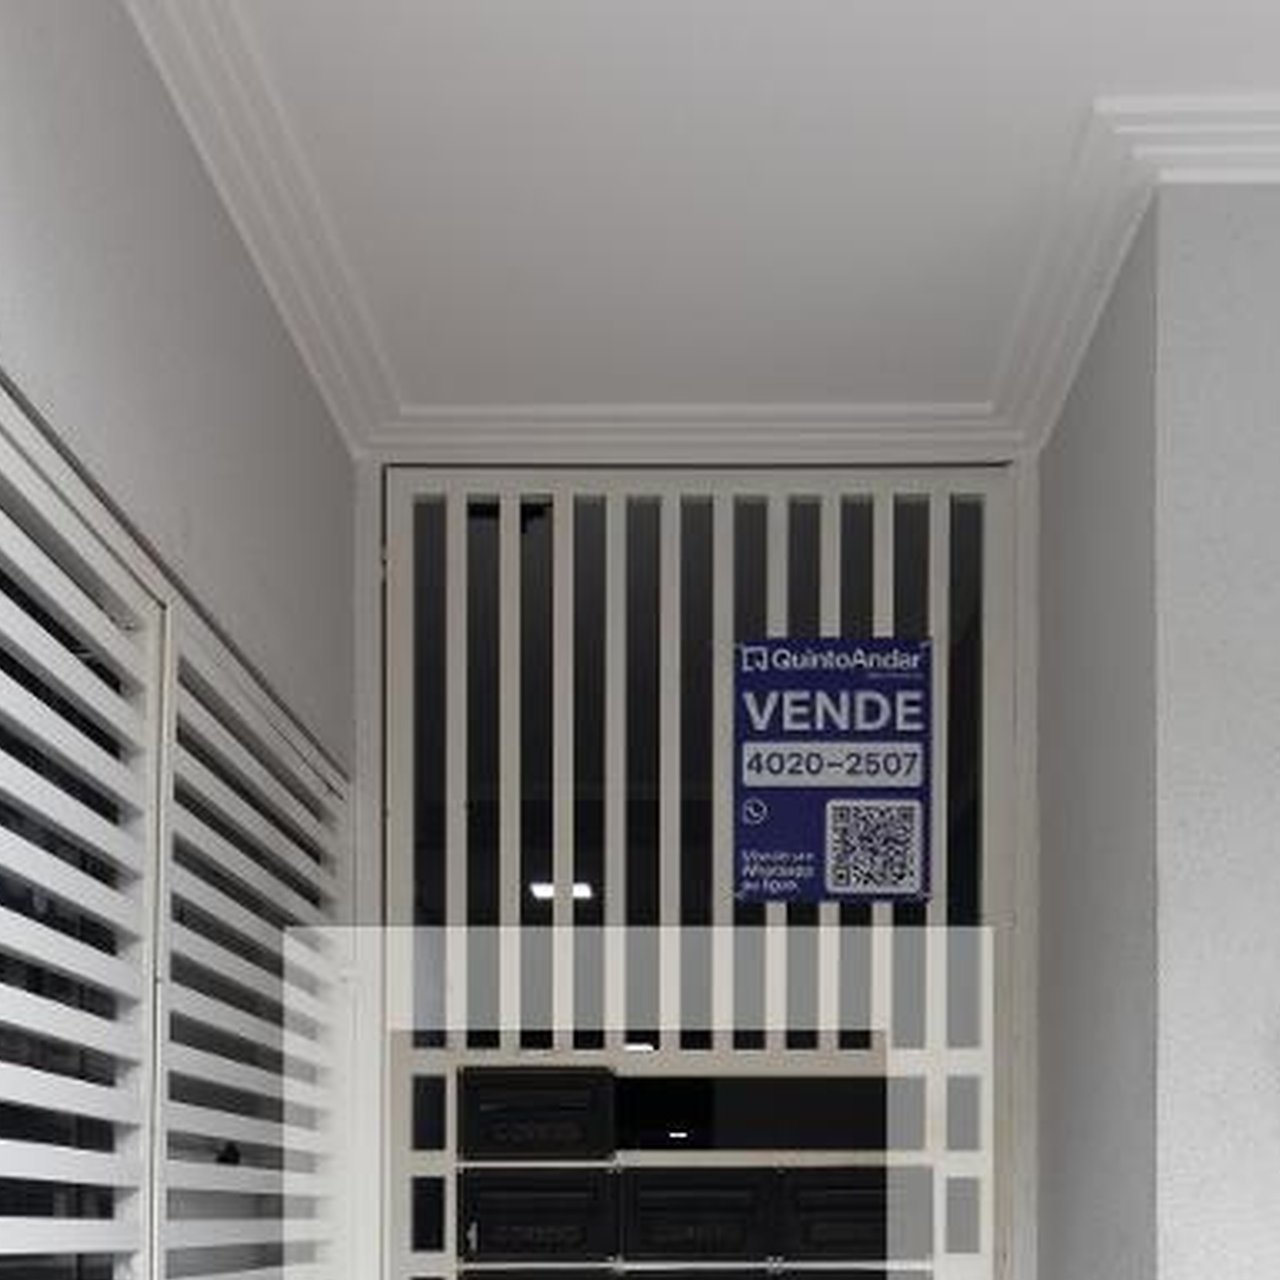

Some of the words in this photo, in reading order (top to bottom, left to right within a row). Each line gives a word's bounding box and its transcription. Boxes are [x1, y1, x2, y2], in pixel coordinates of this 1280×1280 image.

[772, 648, 920, 670] QuintoAndar
[742, 690, 924, 731] VENDE
[746, 752, 919, 776] 4020-2507
